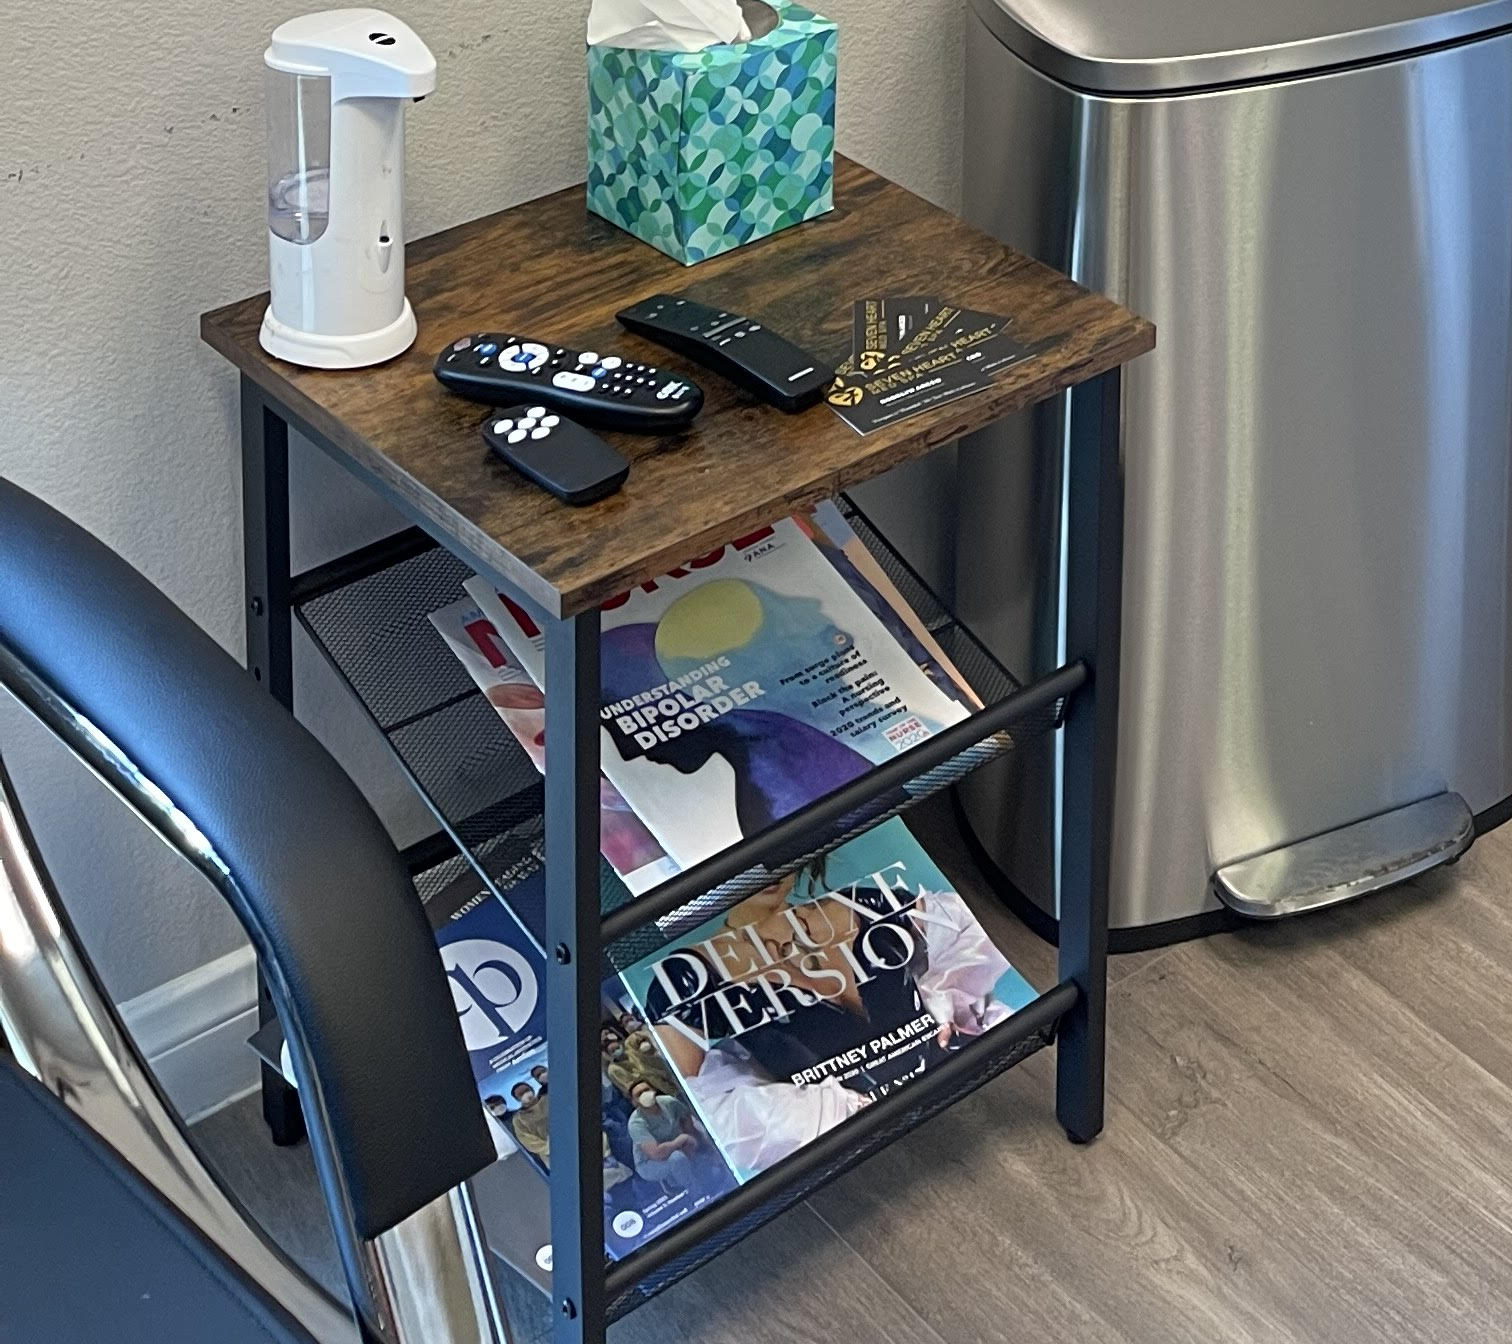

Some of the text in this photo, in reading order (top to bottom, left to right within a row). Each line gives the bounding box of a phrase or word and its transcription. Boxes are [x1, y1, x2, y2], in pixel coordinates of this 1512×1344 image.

[912, 352, 957, 377] HEART
[752, 543, 776, 558] ANA
[600, 655, 731, 720] UNDERSTANDING
[615, 675, 730, 736] BIPOLAR
[633, 680, 766, 751] DISORDER
[885, 696, 901, 709] and
[450, 888, 492, 921] WOMEN
[643, 860, 927, 1007] DELUXE
[651, 889, 962, 1052] VERSION
[790, 1013, 935, 1087] BRITTNEY PALMER
